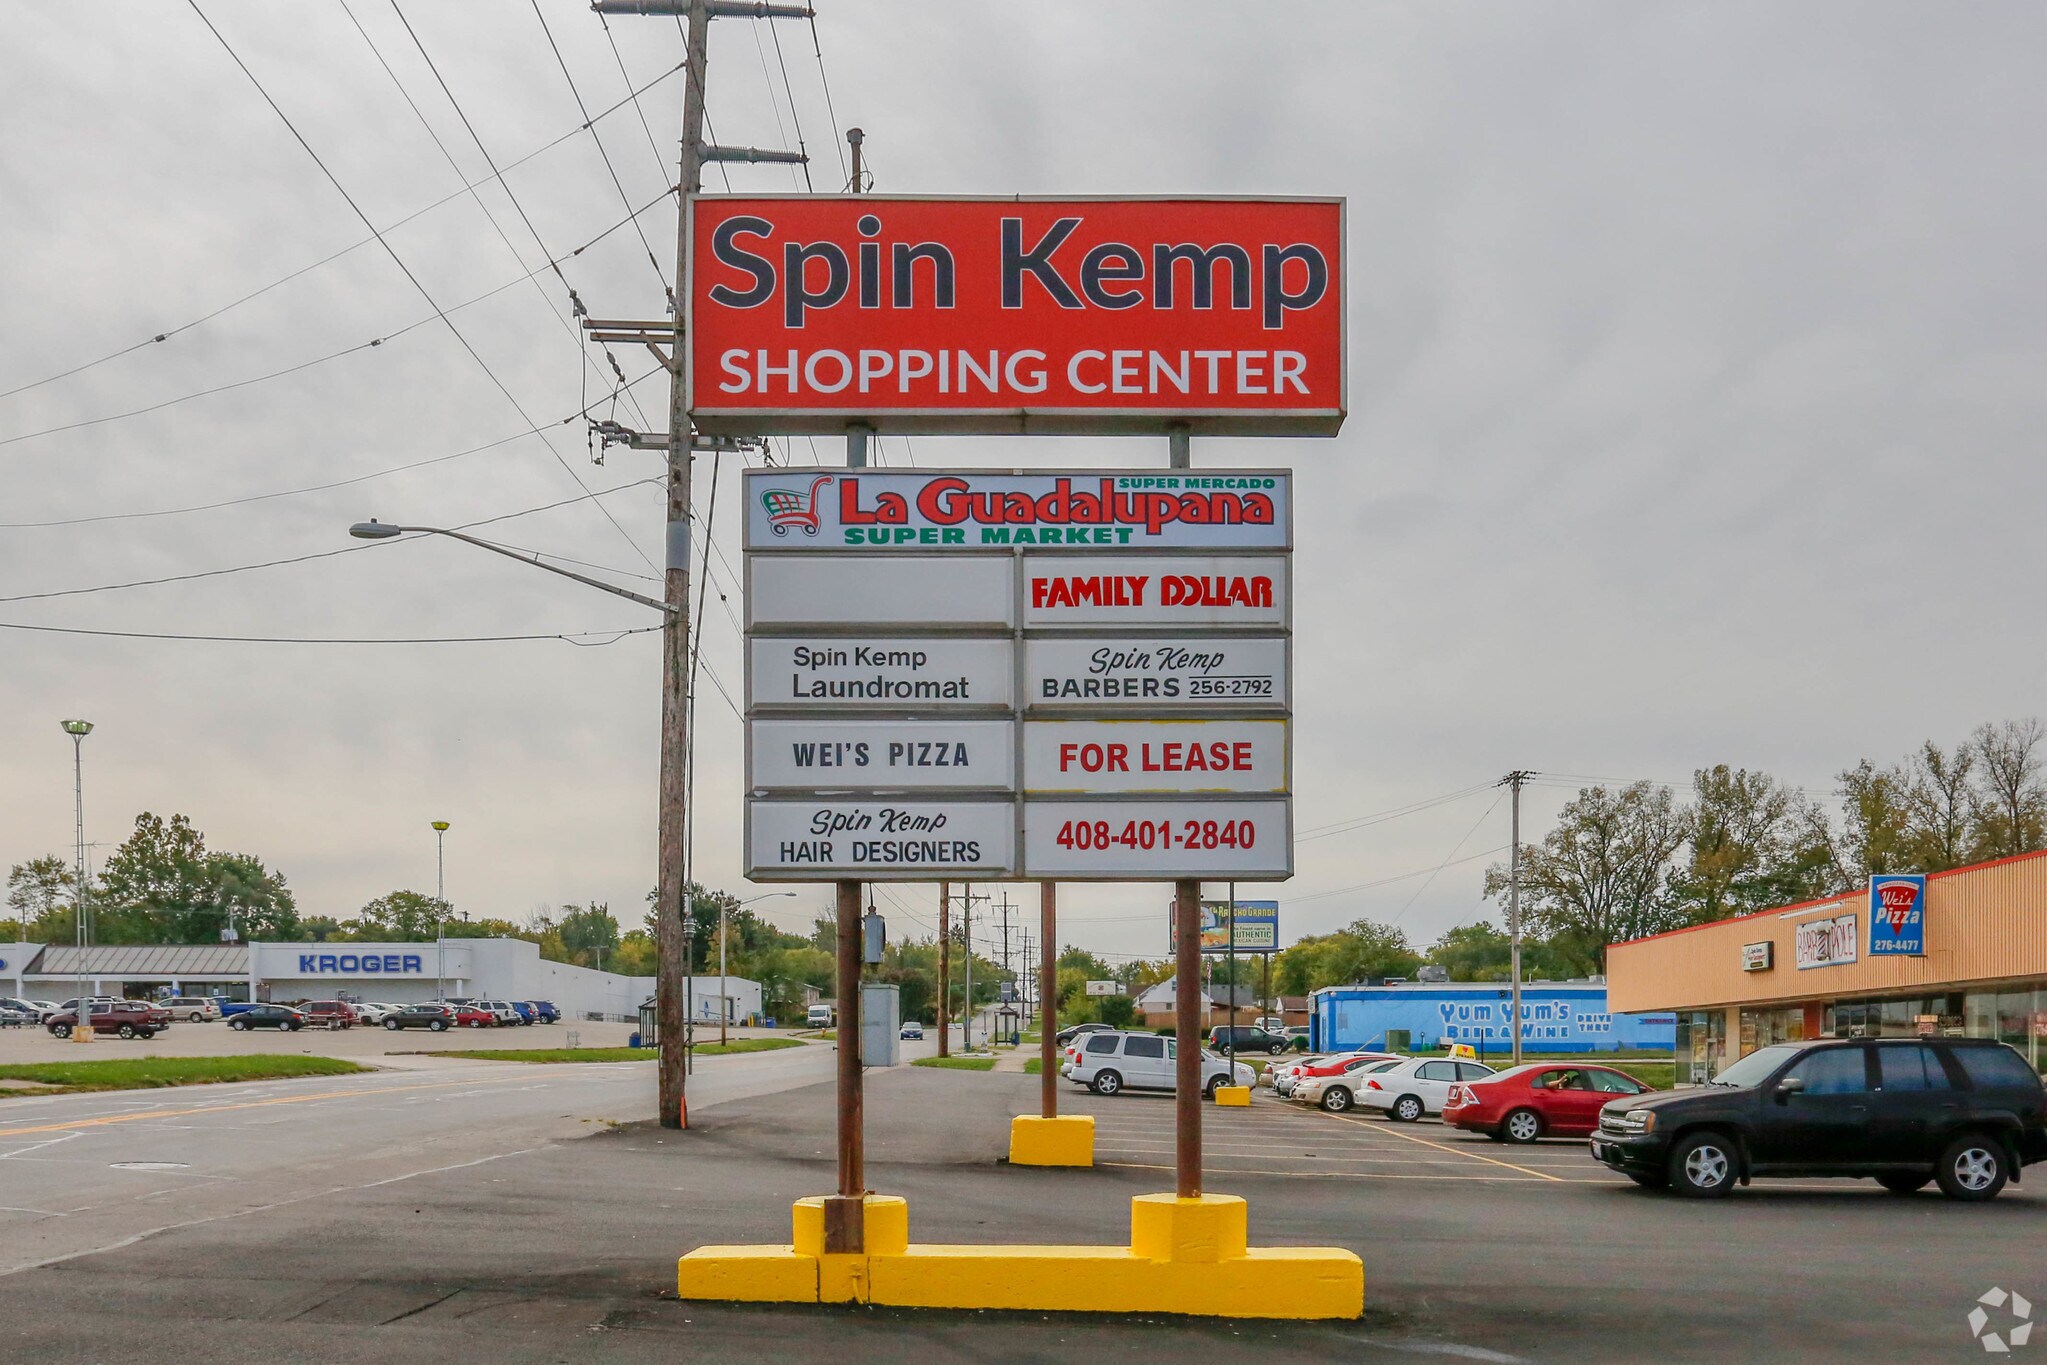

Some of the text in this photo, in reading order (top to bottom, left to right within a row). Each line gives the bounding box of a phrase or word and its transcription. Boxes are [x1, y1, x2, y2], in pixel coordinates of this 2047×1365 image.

[708, 214, 1329, 330] Spin Kemp
[719, 348, 1311, 396] SHOPPING CENTER
[1118, 478, 1275, 489] SUPER MERCADO
[839, 477, 1275, 536] La Guadalupana
[843, 527, 1133, 546] SUPER MARKET
[1031, 575, 1274, 608] FAMILY DOLLAR
[793, 646, 928, 671] Spin Kemp
[1088, 647, 1225, 674] Spin Kemp
[793, 674, 970, 699] Laundromat
[1042, 678, 1273, 698] BARBERS 256-2792
[792, 742, 970, 768] WEI'S PIZZA
[1059, 742, 1254, 773] FOR LEASE
[809, 808, 948, 835] Spin Kemp
[1056, 819, 1256, 851] 408-401-2840
[779, 841, 981, 863] HAIR DESIGNERS
[1881, 890, 1914, 906] Wei's
[1218, 906, 1247, 917] RACHO
[1875, 907, 1921, 924] Pizza
[1875, 939, 1919, 951] 276-4477
[298, 954, 423, 974] KROGER
[1577, 1014, 1612, 1023] DRIVE
[1579, 1023, 1611, 1032] THRU
[1500, 1026, 1512, 1038] &
